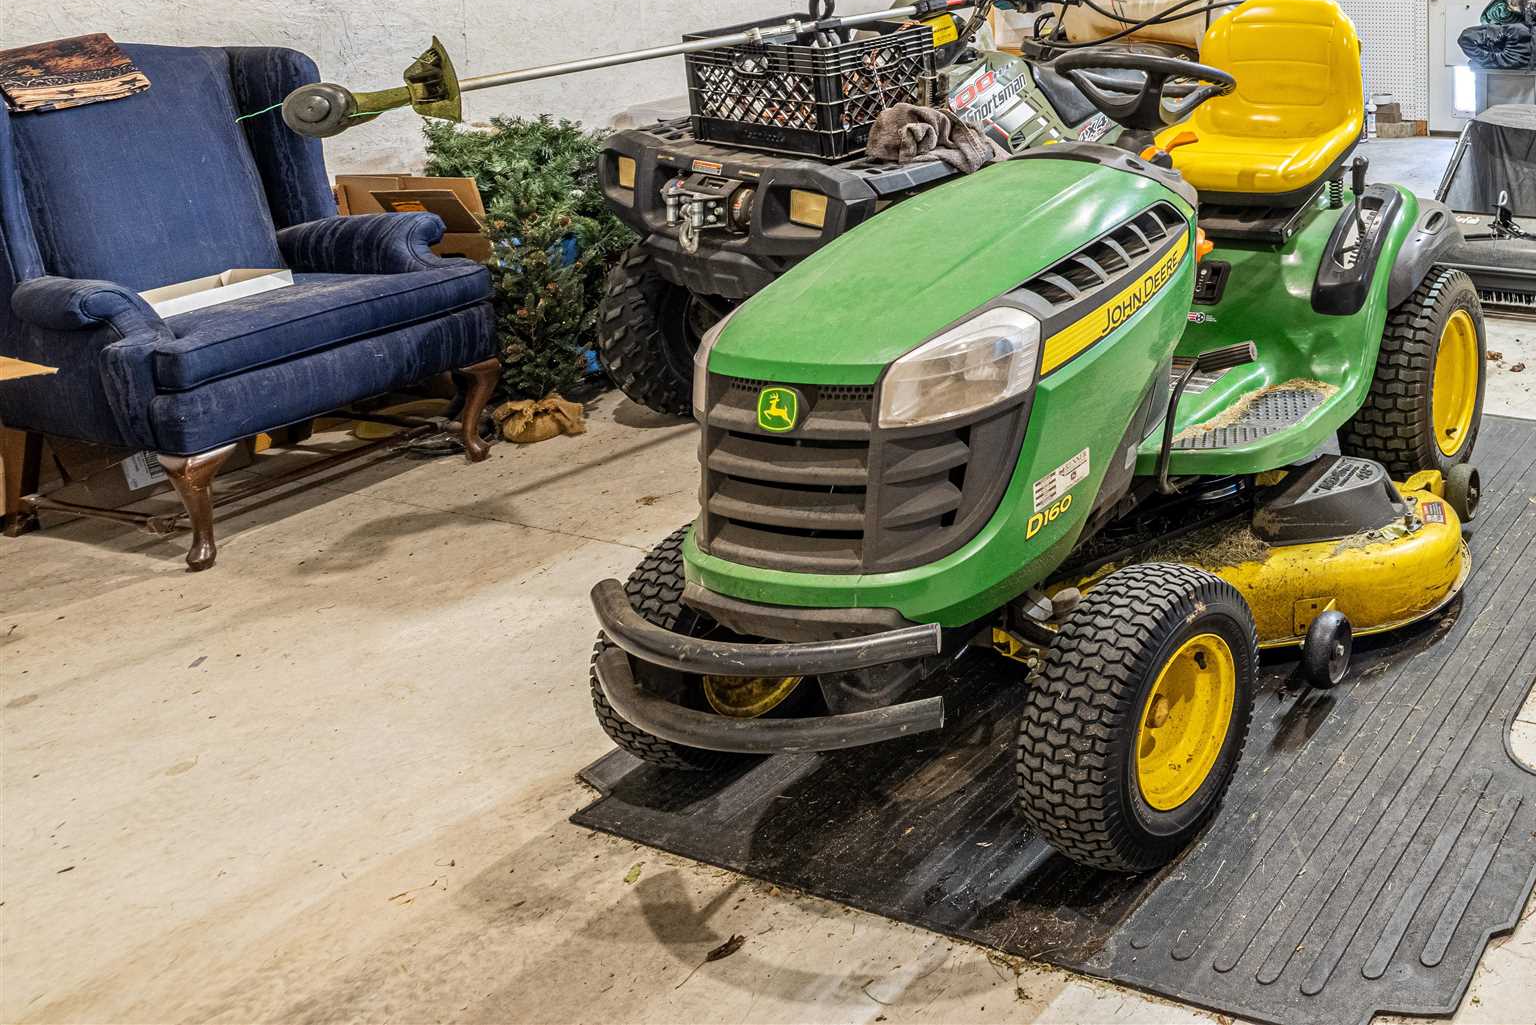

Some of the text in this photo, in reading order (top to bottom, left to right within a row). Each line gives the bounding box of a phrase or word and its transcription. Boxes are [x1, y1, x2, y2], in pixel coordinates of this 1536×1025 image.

[961, 73, 1026, 122] Sportsman
[1102, 250, 1178, 333] JOHN DEERE
[1025, 494, 1073, 541] D160
